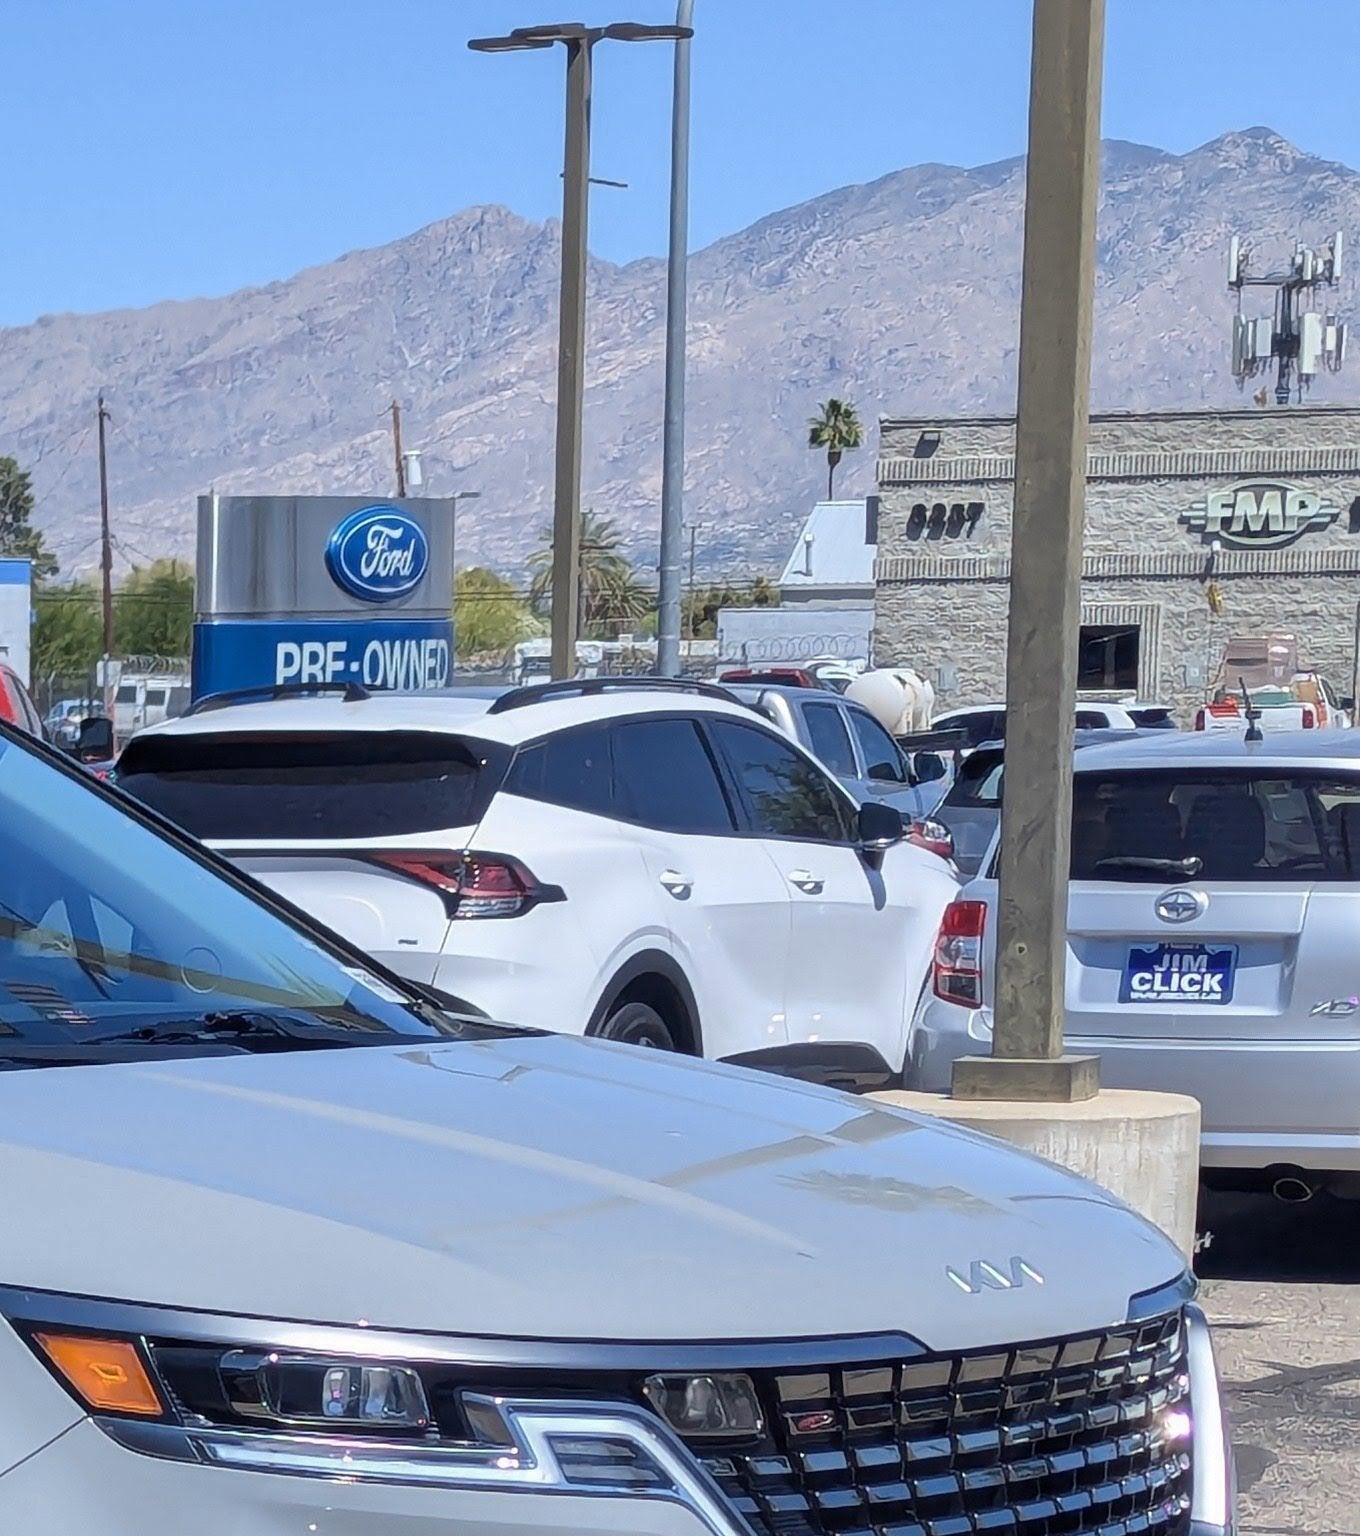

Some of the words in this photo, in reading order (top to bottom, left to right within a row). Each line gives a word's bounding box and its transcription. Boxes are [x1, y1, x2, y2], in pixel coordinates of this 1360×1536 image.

[1204, 490, 1322, 533] FMP
[360, 525, 416, 579] Ford
[1153, 953, 1209, 973] JIM
[1131, 972, 1224, 992] CLICK
